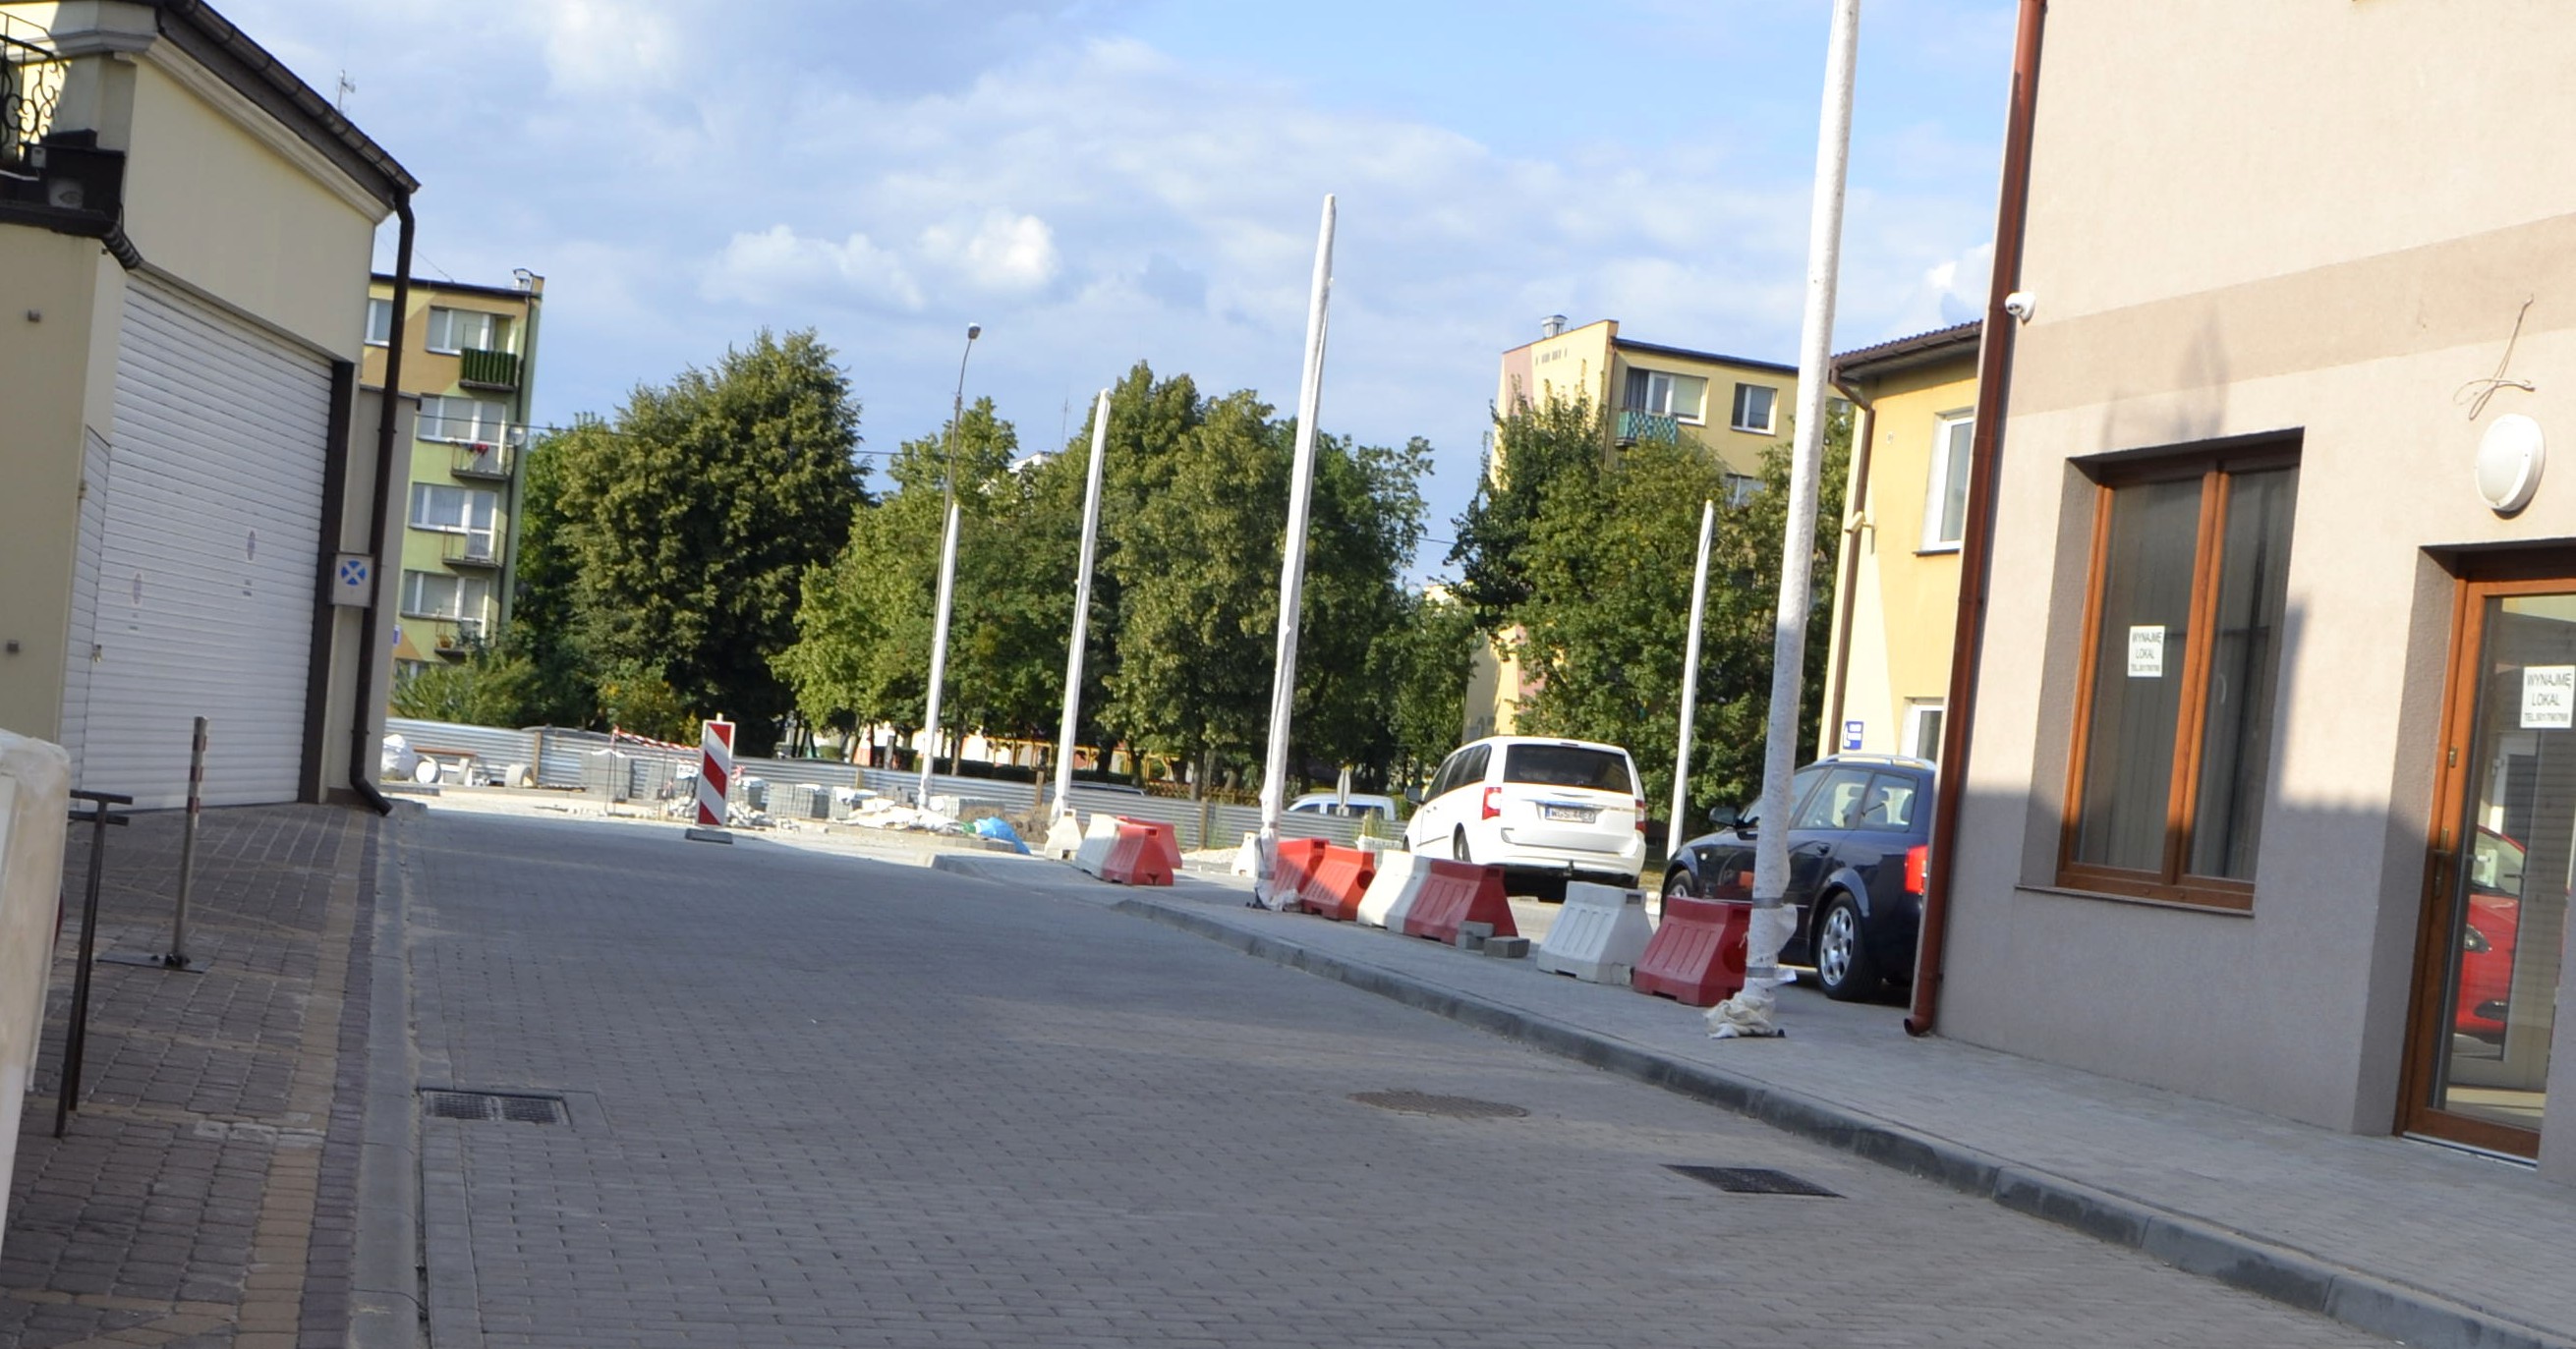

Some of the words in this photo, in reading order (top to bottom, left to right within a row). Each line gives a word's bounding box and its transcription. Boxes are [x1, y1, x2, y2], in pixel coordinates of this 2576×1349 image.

[2135, 648, 2154, 659] LOKAL
[2527, 673, 2571, 689] WYNAJMĘ
[2532, 693, 2561, 706] LOKAL
